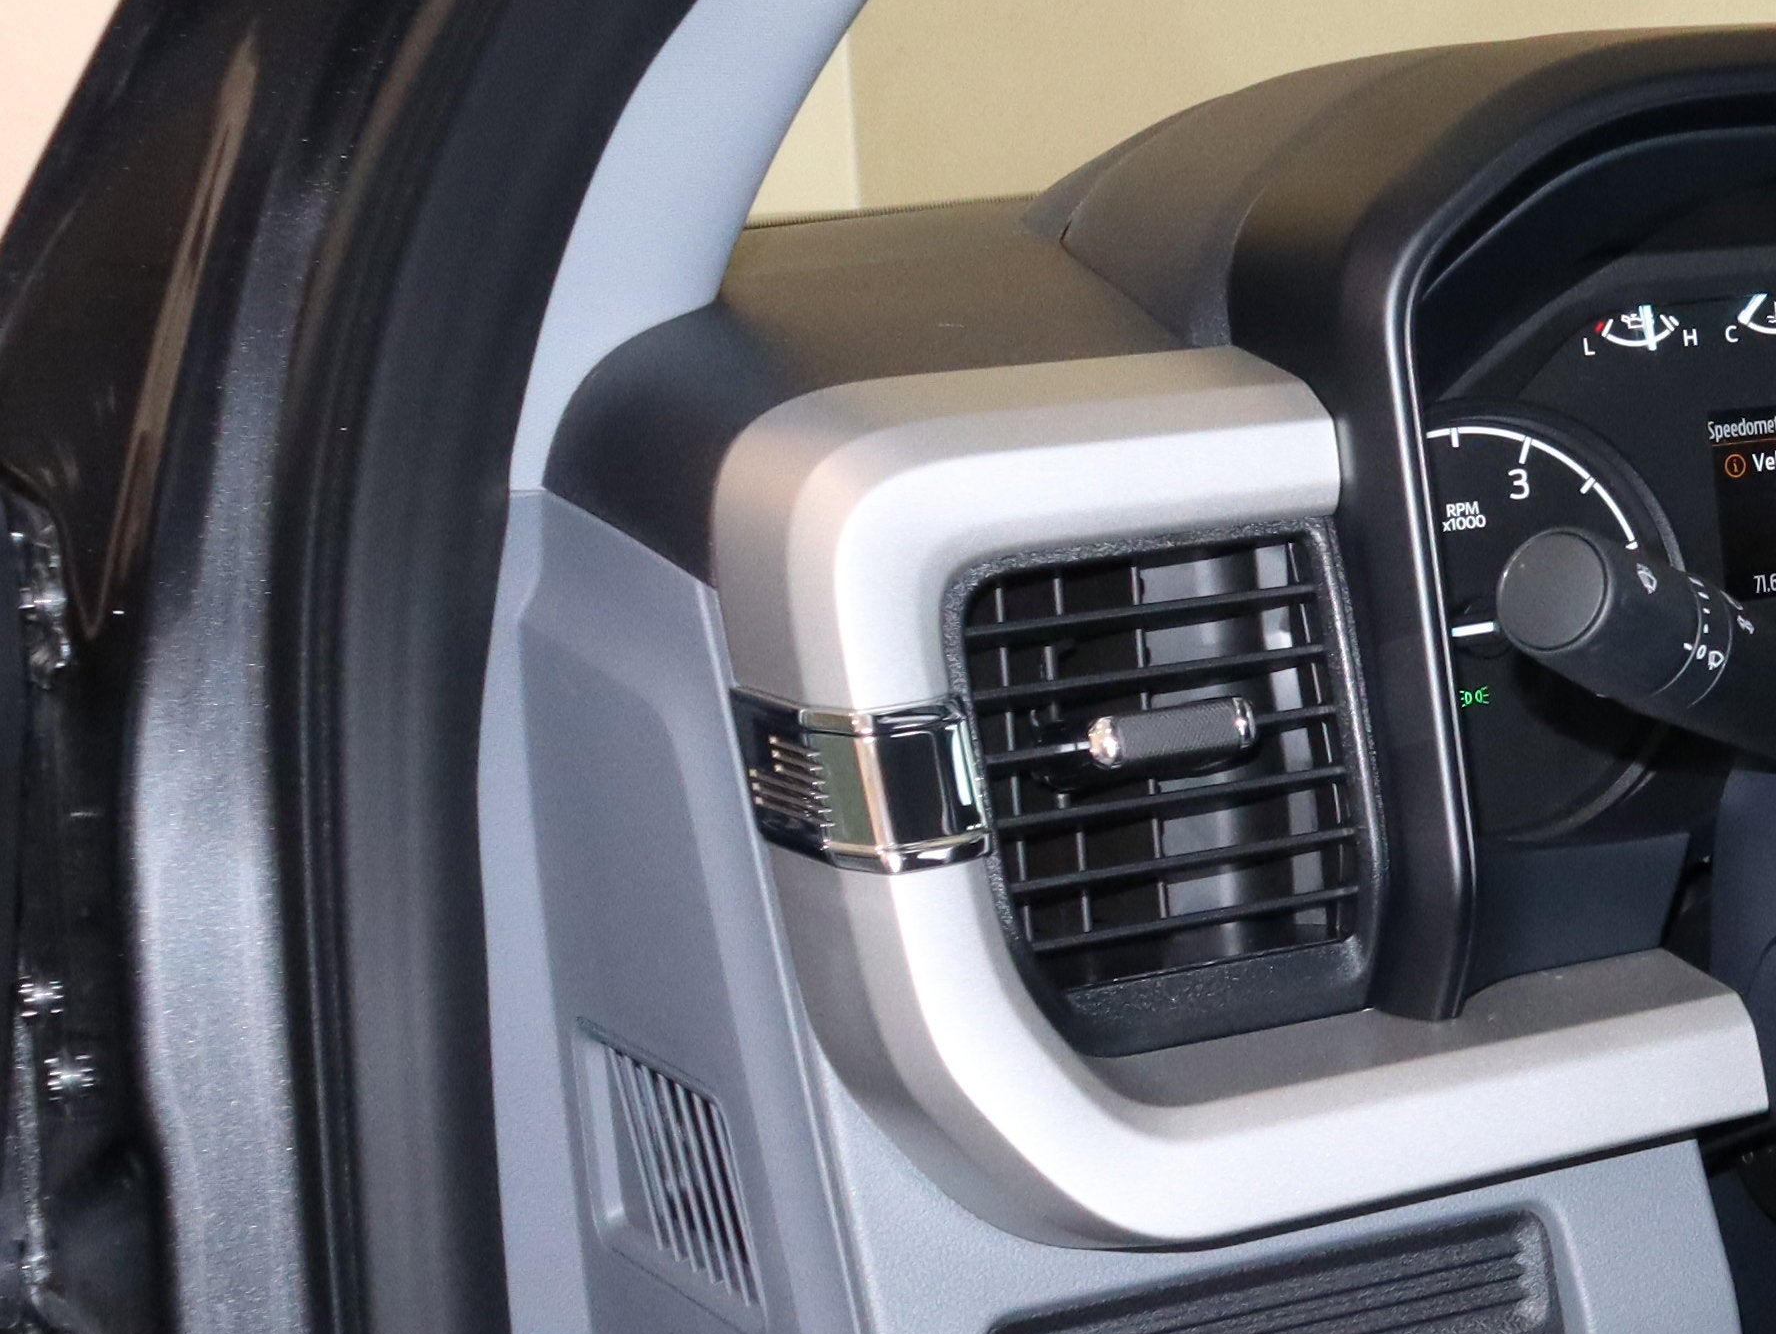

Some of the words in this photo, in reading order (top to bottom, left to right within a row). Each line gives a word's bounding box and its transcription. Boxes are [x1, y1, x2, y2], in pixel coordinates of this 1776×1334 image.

[1683, 328, 1698, 347] H
[1725, 325, 1739, 343] C
[1583, 337, 1595, 356] L
[1507, 468, 1530, 500] 3
[1446, 501, 1480, 518] RPM
[1442, 514, 1486, 533] x1000
